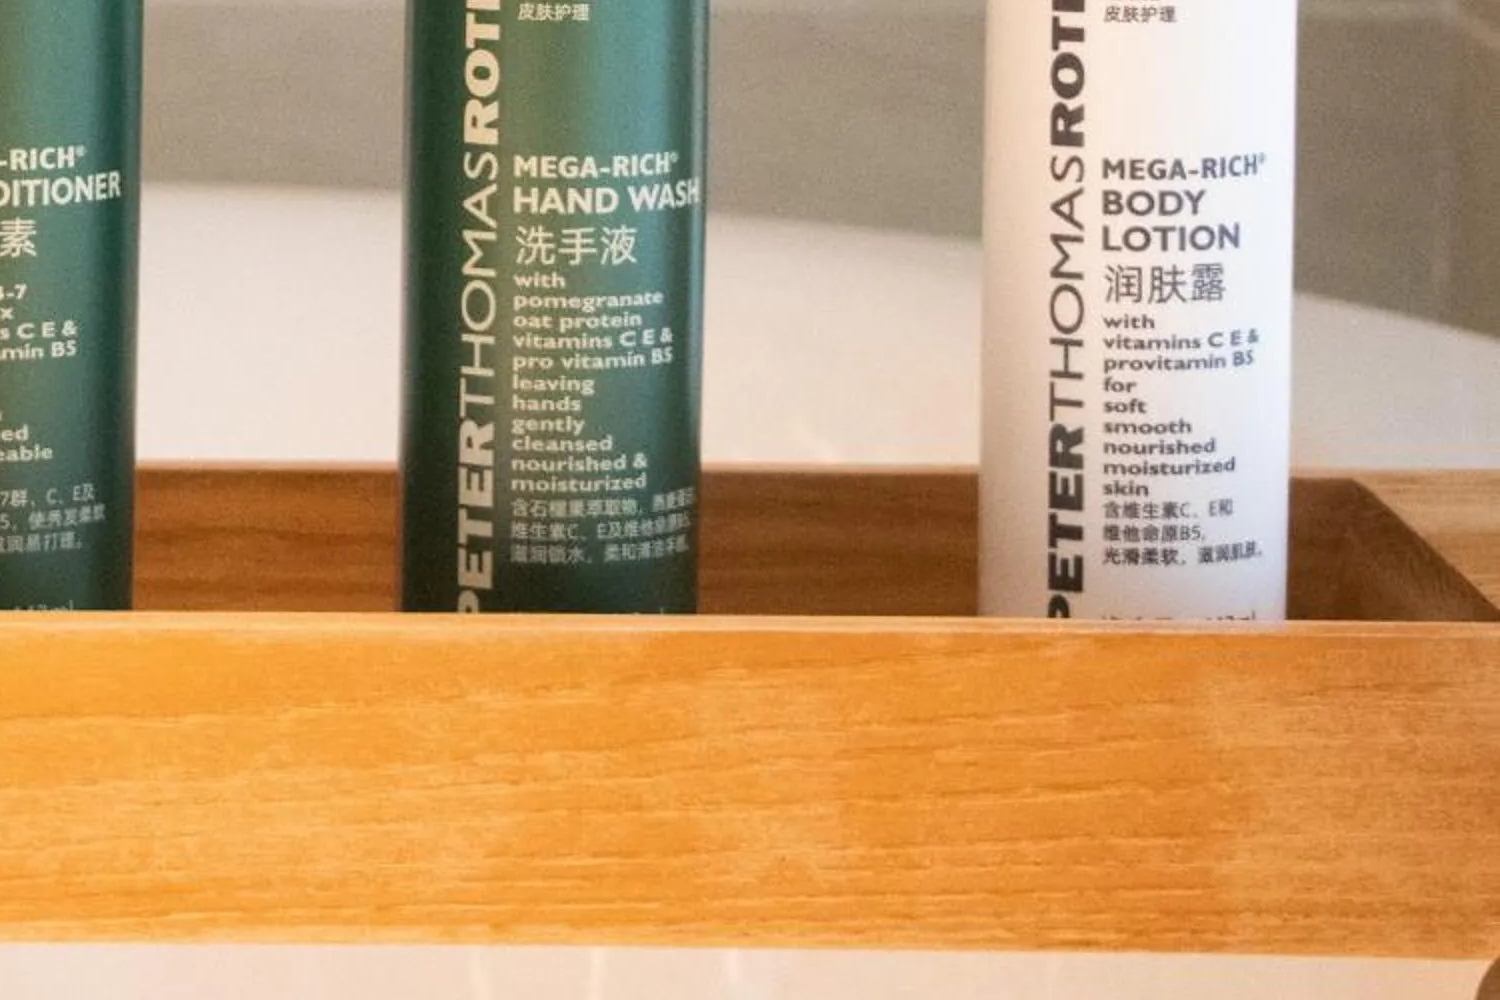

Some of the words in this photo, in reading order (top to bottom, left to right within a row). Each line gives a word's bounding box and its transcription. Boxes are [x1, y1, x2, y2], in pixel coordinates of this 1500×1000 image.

[518, 3, 589, 22] 皮肤护理
[1104, 6, 1176, 23] 皮肤护理
[513, 186, 619, 214] HAND
[627, 176, 701, 212] WASH
[1103, 189, 1206, 216] BODY
[516, 225, 638, 265] 洗手液
[1102, 223, 1240, 252] LOTION
[513, 272, 566, 289] with
[1104, 262, 1226, 304] 润肤露
[513, 291, 664, 313] pomegranate
[16, 323, 34, 339] C
[42, 322, 56, 338] E
[61, 320, 78, 336] &
[513, 314, 552, 328] oat
[559, 312, 642, 333] protein
[1103, 314, 1155, 329] with
[51, 340, 77, 357] B5
[513, 332, 612, 349] vitamins
[619, 331, 637, 346] C
[642, 329, 655, 345] E
[660, 328, 672, 344] &
[1103, 334, 1201, 351] vitamins
[1208, 333, 1224, 348] C
[1230, 330, 1242, 346] E
[1248, 329, 1259, 344] &
[513, 355, 553, 372] pro
[562, 351, 645, 369] vitamin
[651, 348, 672, 364] B5
[1103, 354, 1226, 374] provitamin
[1232, 350, 1254, 367] B5
[512, 376, 595, 396] leaving
[1103, 378, 1137, 393] for
[512, 396, 581, 412] hands
[1103, 399, 1147, 414] soft
[512, 416, 585, 436] gently
[1103, 419, 1192, 434] smooth
[512, 435, 612, 451] cleansed
[1103, 438, 1216, 455] nourished
[511, 455, 627, 471] nourished
[633, 452, 648, 469] &
[1103, 456, 1235, 476] moisturized
[511, 472, 646, 492] moisturized
[1103, 482, 1149, 496] skin
